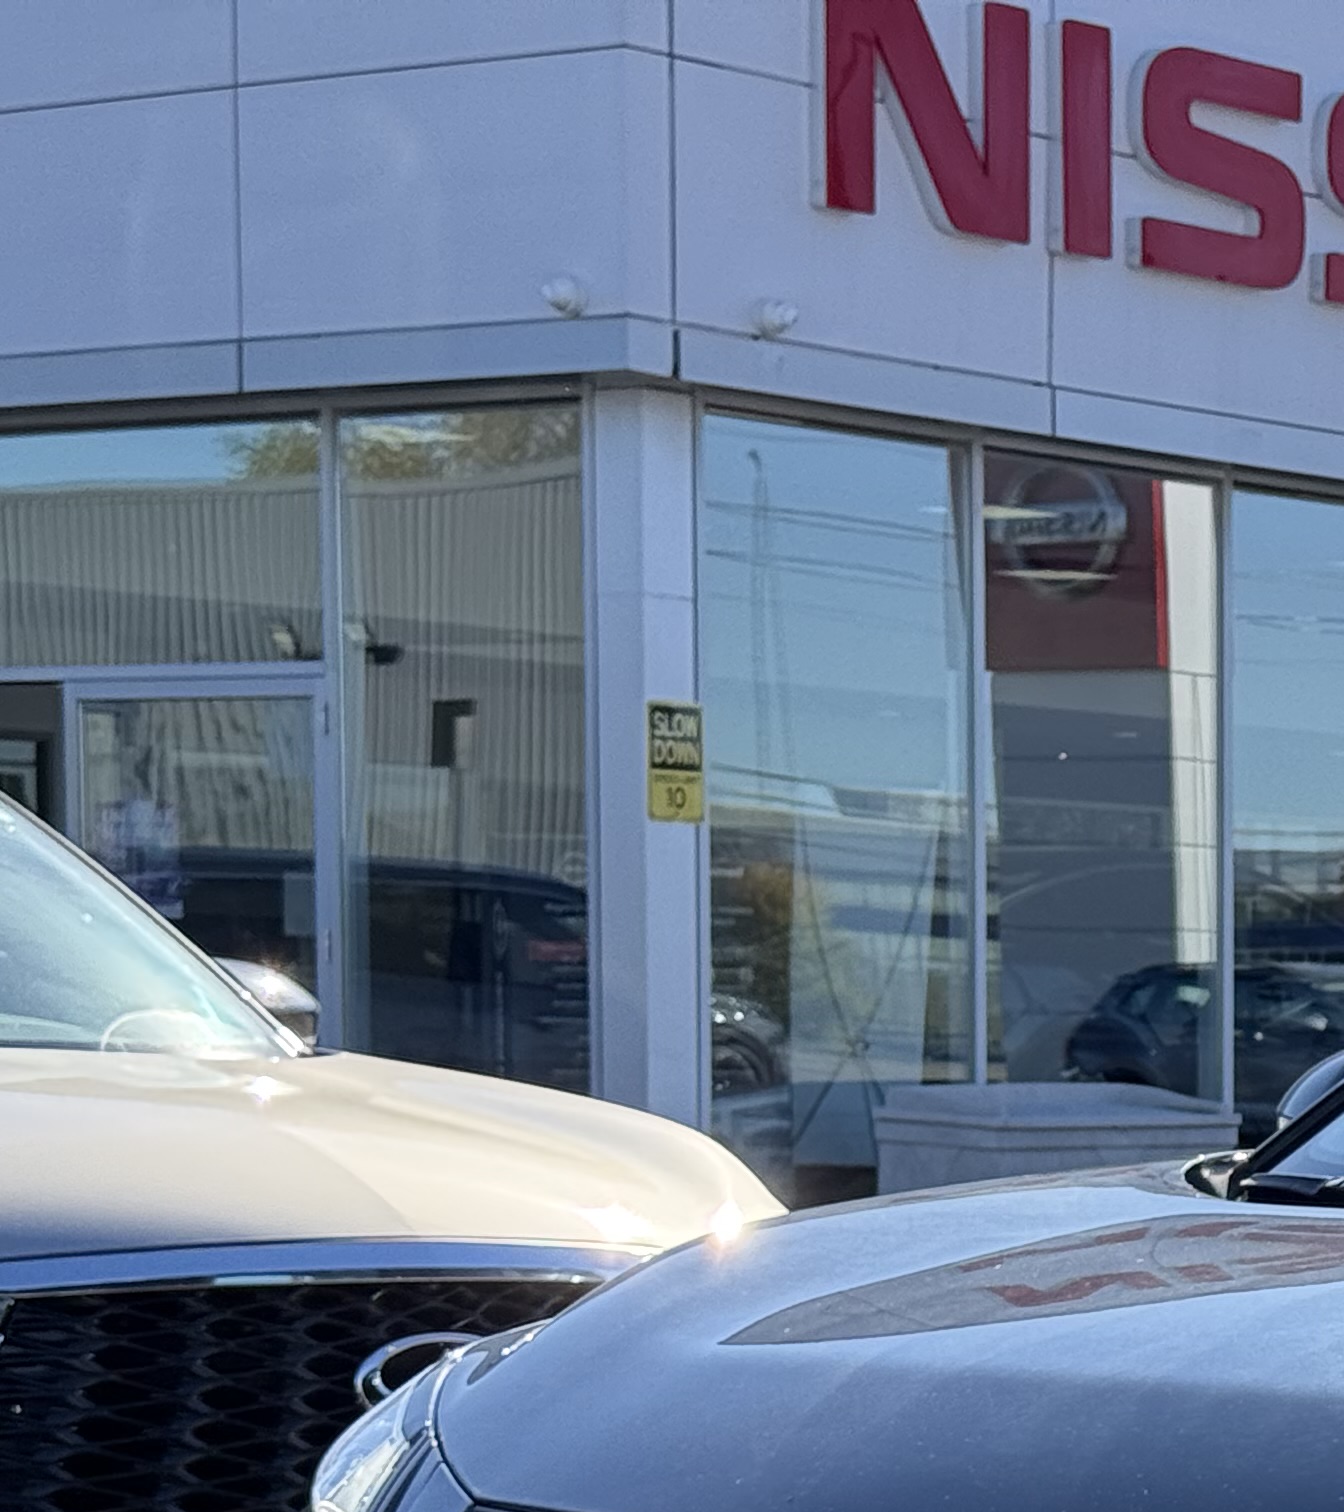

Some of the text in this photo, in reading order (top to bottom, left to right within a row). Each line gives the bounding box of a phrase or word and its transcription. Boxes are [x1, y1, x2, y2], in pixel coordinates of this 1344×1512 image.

[653, 711, 699, 737] SLOW
[654, 739, 700, 765] DOWN
[666, 786, 687, 811] 10
